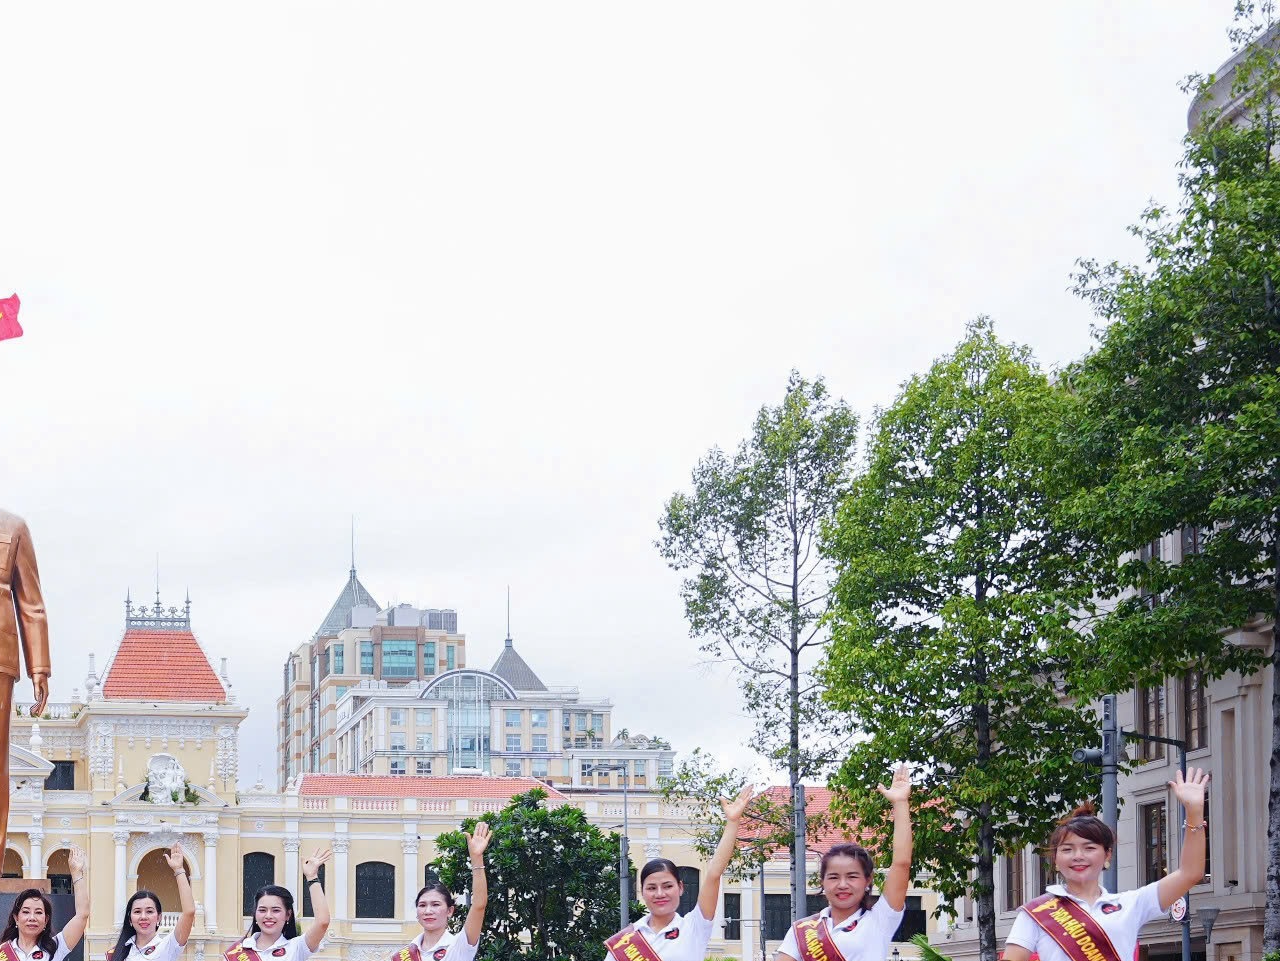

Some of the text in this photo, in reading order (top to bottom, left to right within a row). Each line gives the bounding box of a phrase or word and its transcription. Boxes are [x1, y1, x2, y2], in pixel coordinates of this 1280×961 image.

[1049, 908, 1072, 927] HOA
[1062, 919, 1088, 940] HẬU
[624, 943, 640, 960] HOA
